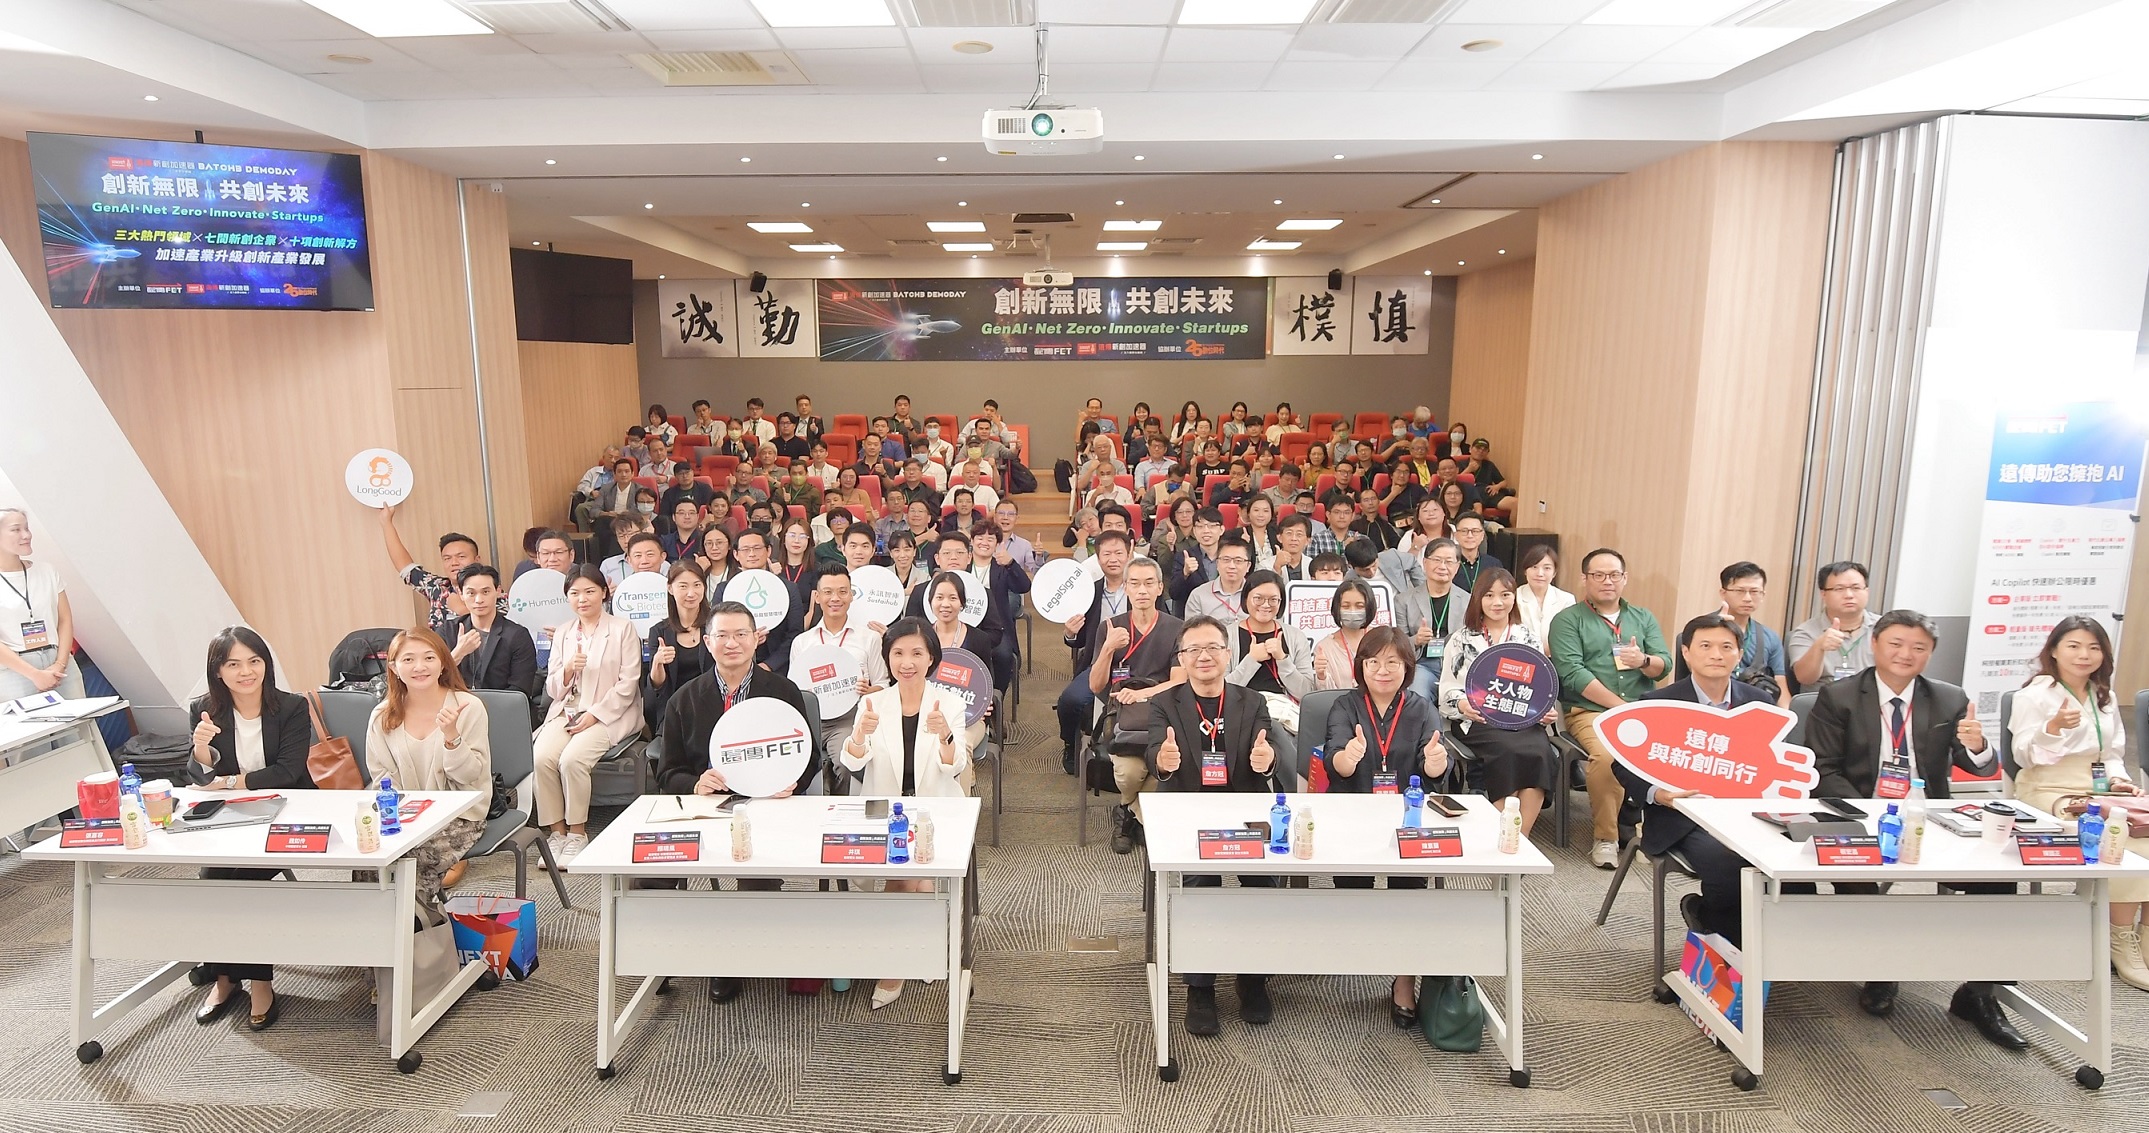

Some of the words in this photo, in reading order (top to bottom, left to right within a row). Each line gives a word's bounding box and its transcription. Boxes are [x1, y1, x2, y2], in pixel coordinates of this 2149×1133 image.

[245, 165, 298, 176] DEMODAY
[101, 173, 200, 199] 創新無限
[219, 180, 310, 204] 共創未來
[155, 248, 326, 266] 加速產業升級創新產業發展
[994, 287, 1102, 315] 創新無限
[1125, 287, 1235, 315] 共創未來
[672, 293, 724, 344] 誠
[754, 290, 800, 347] 勤
[1288, 291, 1336, 342] 樸
[1368, 289, 1416, 343] 慎
[1999, 463, 2104, 483] 遠傳助您擁抱
[2106, 466, 2124, 481] AI
[357, 485, 402, 497] LongGood
[1041, 566, 1083, 613] LegalSign.ai
[2002, 578, 2030, 588] Copilot
[1488, 678, 1534, 701] 大人物
[1483, 693, 1529, 718] 生態圈
[1683, 727, 1731, 755] 遠傳
[1647, 742, 1758, 785] 與新創同行
